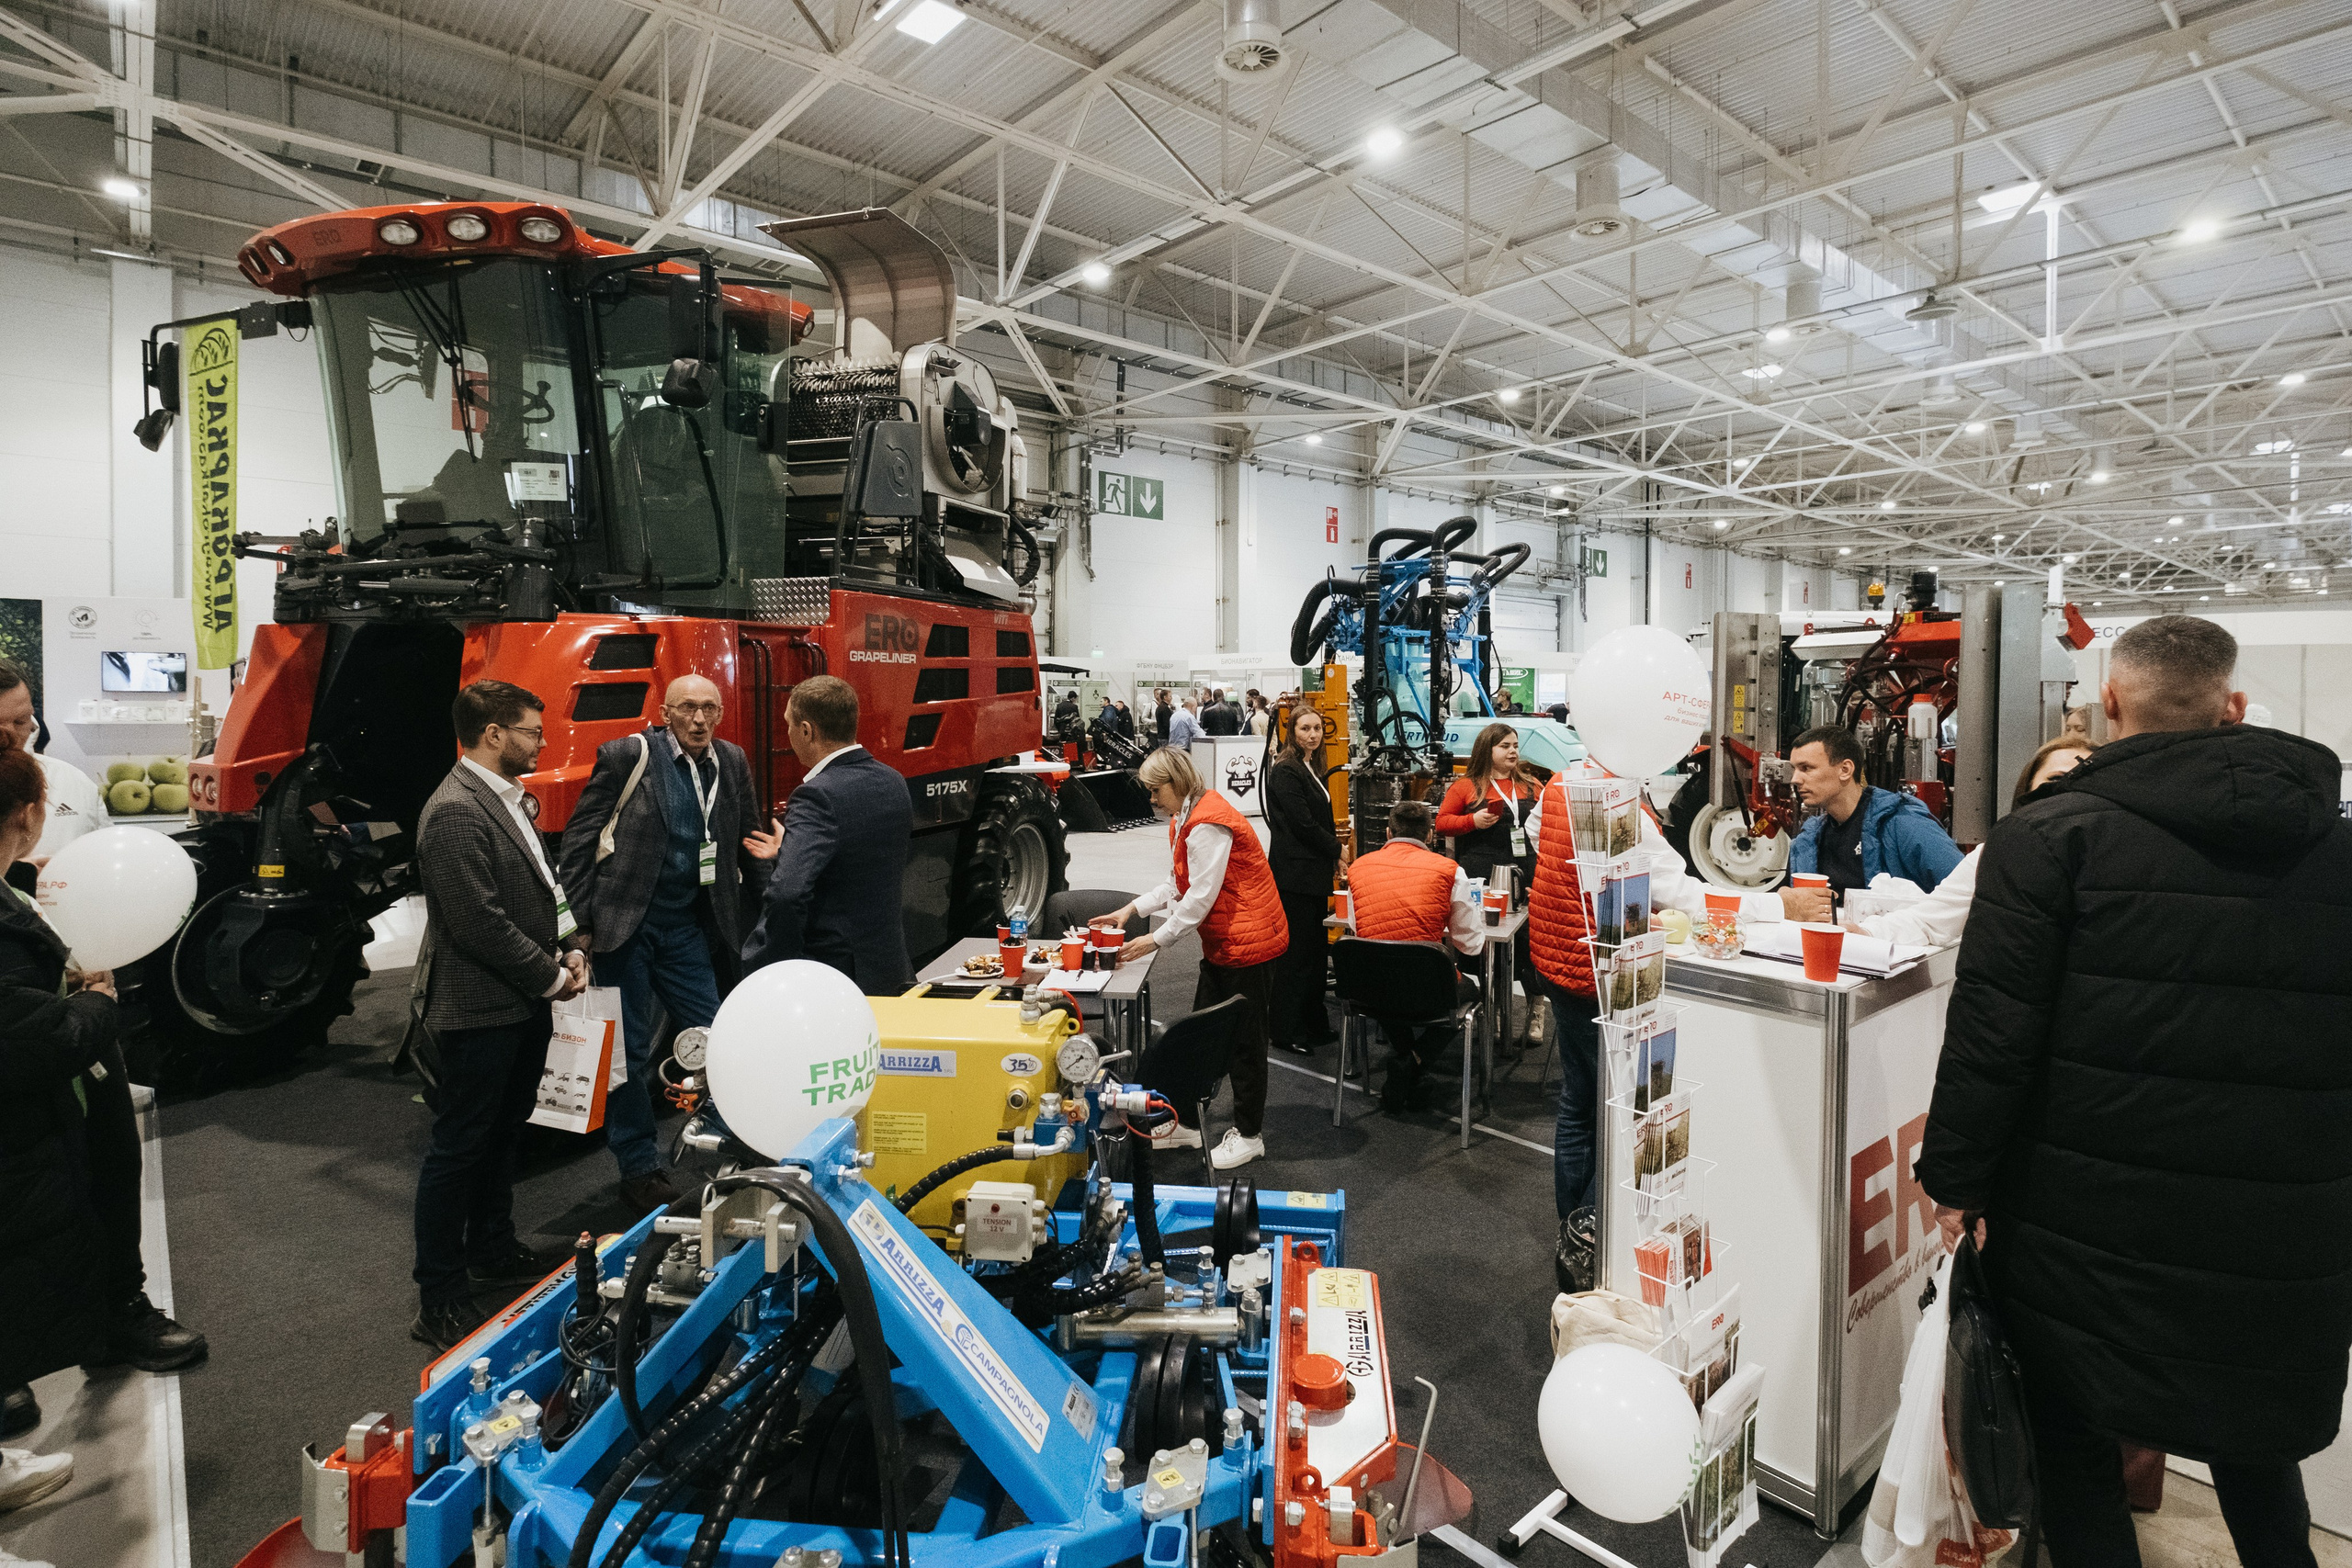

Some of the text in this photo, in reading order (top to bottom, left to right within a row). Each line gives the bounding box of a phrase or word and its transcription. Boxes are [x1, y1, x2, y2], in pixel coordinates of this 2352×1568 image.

[865, 614, 919, 652] ERO
[849, 650, 917, 663] GRAPELINER
[926, 780, 968, 797] 5175X
[561, 1032, 587, 1044] БИЗОН
[801, 1067, 877, 1107] TRAD
[983, 1218, 1012, 1226] TENSION
[1712, 1313, 1724, 1331] ERO
[880, 1237, 944, 1318] ARRIZZA
[970, 1343, 1044, 1437] CAMPAGNOLA
